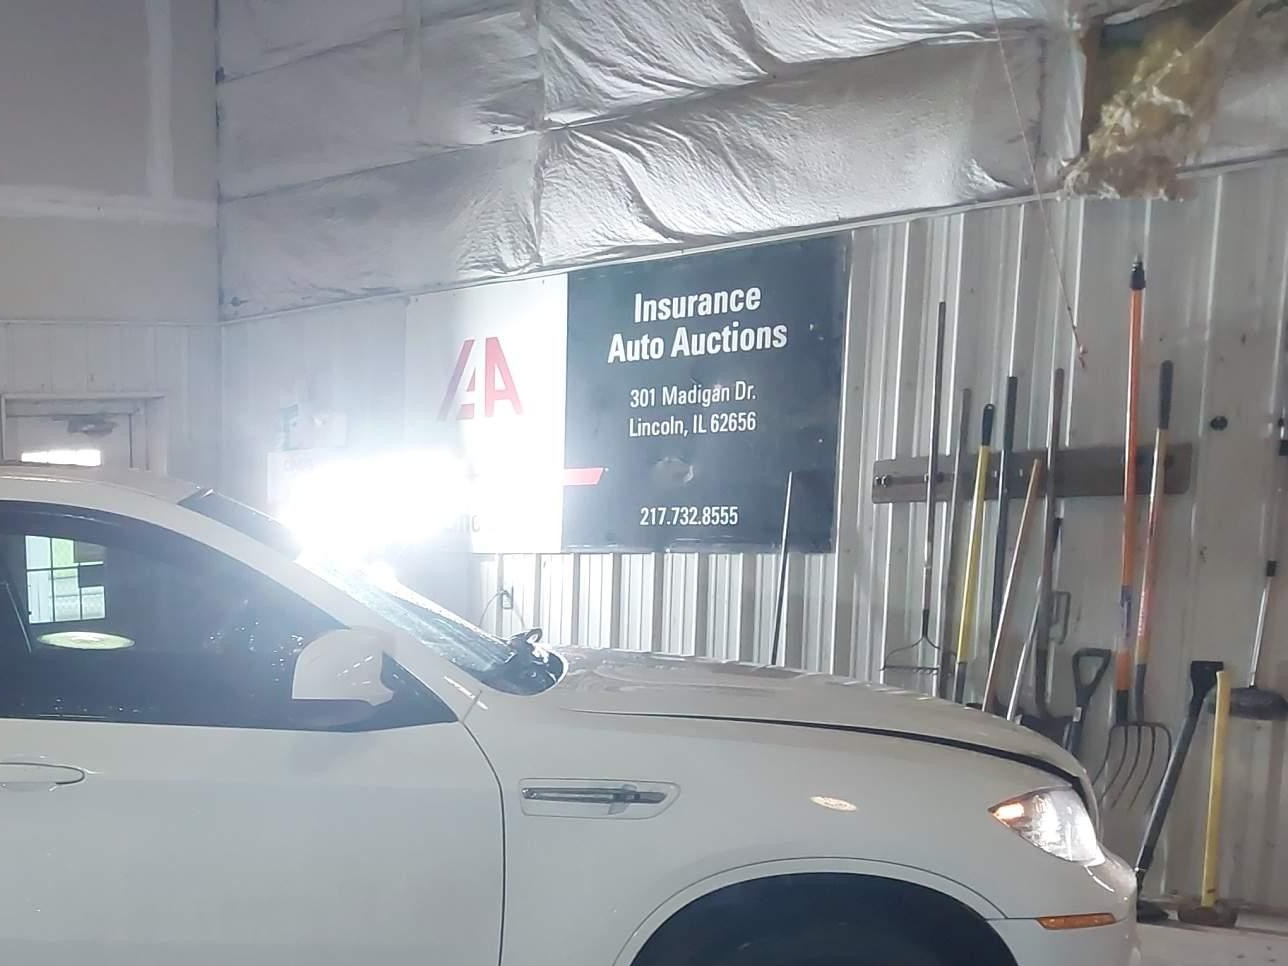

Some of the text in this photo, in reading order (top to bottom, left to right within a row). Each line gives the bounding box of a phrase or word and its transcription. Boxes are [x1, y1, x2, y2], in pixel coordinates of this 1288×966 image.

[634, 285, 762, 324] Insurance
[607, 322, 789, 364] Auto Auctions
[629, 381, 757, 408] 301 Madigan Dr.
[629, 411, 757, 438] Lincoln, IL 62656
[639, 506, 739, 527] 217.732.8555
